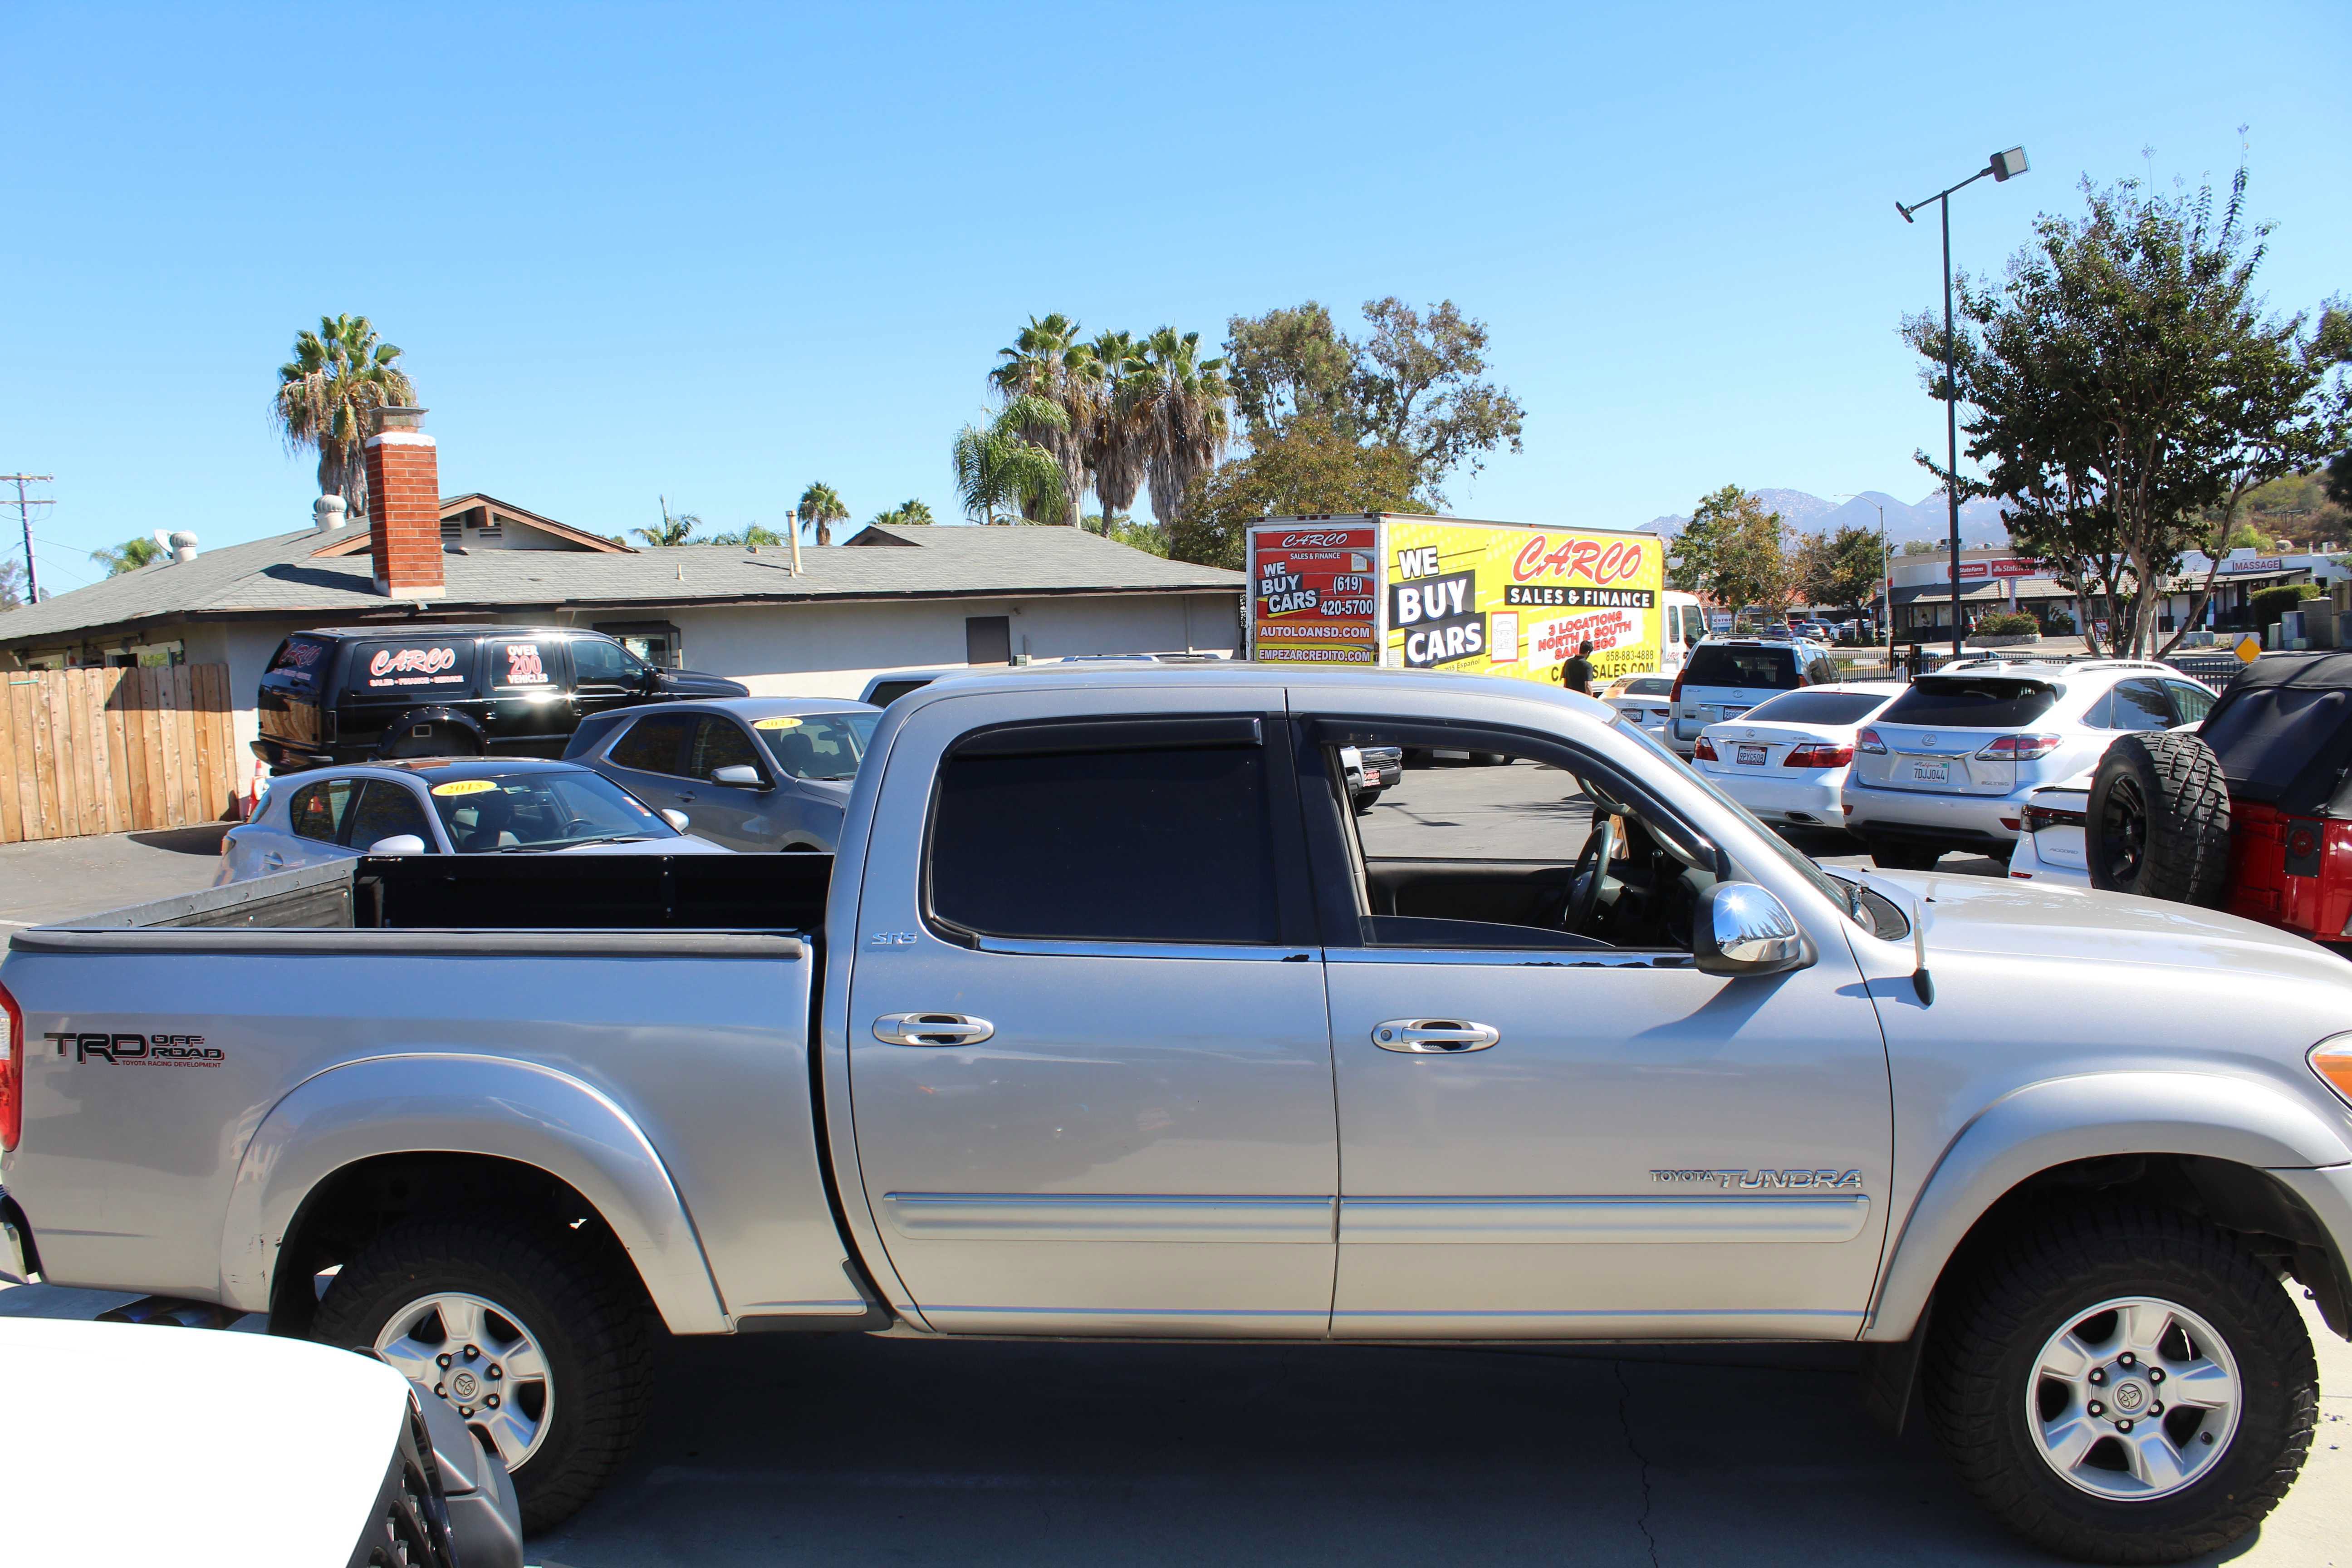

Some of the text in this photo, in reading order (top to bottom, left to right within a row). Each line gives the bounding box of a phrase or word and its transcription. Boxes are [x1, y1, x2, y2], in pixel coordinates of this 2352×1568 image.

[1282, 533, 1348, 548] CARCO
[1397, 545, 1439, 579] WE
[1513, 535, 1641, 585] CARCO
[2235, 560, 2278, 570] MASSAGE
[1263, 562, 1285, 577] WE
[1262, 575, 1299, 595] BUY
[1333, 576, 1362, 595] (619)
[1269, 590, 1316, 612] CARS
[1398, 578, 1467, 625] BUY
[1510, 588, 1650, 607] SALES & FINANCE
[1321, 599, 1373, 615] 420-5700
[1548, 611, 1622, 636] 3 LOCATIONS
[1260, 627, 1370, 638] AUTOLOANSD.COM
[1538, 621, 1632, 651] NORTH & SOUTH
[508, 645, 539, 656] OVER
[1407, 622, 1482, 664] CARS
[1555, 636, 1617, 660] SAN EGO
[371, 648, 456, 676] CARCO
[1259, 650, 1370, 662] EMPEZARCREDITO.COM
[1457, 658, 1480, 669] Español
[1606, 650, 1654, 661] 858-883-4888
[509, 656, 542, 675] 200
[508, 673, 549, 684] VEHICLES
[1740, 753, 1764, 762] 9PYG508
[1914, 768, 1945, 779] 7DJJ044
[447, 782, 483, 794] 2015
[871, 931, 917, 945] SR5
[44, 1032, 205, 1065] TRD OFF
[151, 1047, 225, 1061] ROAD
[1650, 1169, 1862, 1189] TOYOTA TUNDRA
